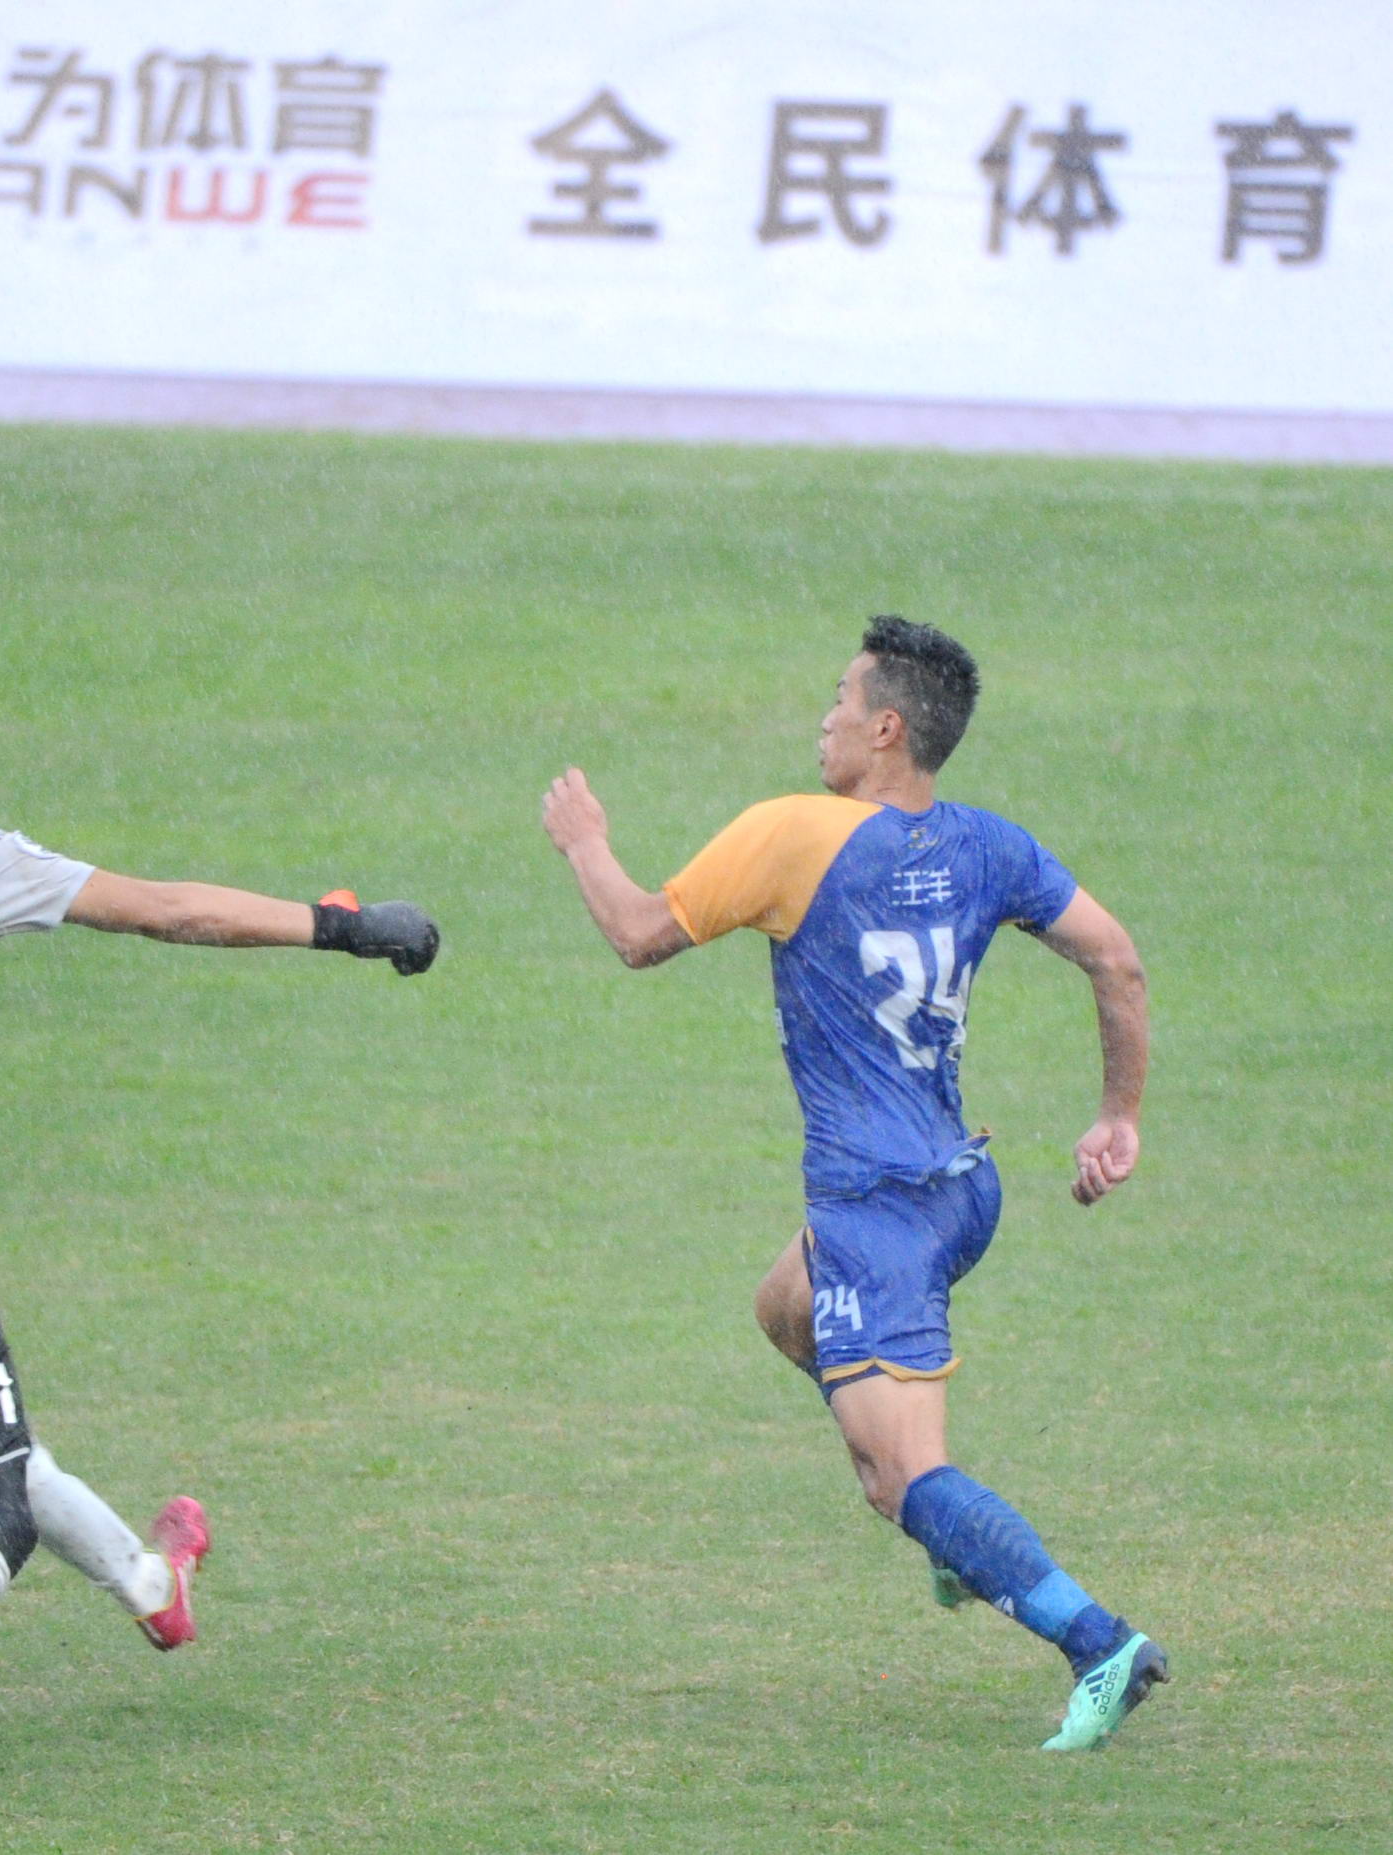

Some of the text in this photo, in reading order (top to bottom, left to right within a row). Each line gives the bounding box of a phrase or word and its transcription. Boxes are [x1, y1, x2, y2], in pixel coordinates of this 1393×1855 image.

[527, 87, 1355, 264] 全民体育
[860, 926, 972, 1070] 24
[814, 1284, 863, 1341] 24
[1098, 1663, 1120, 1715] adidas
